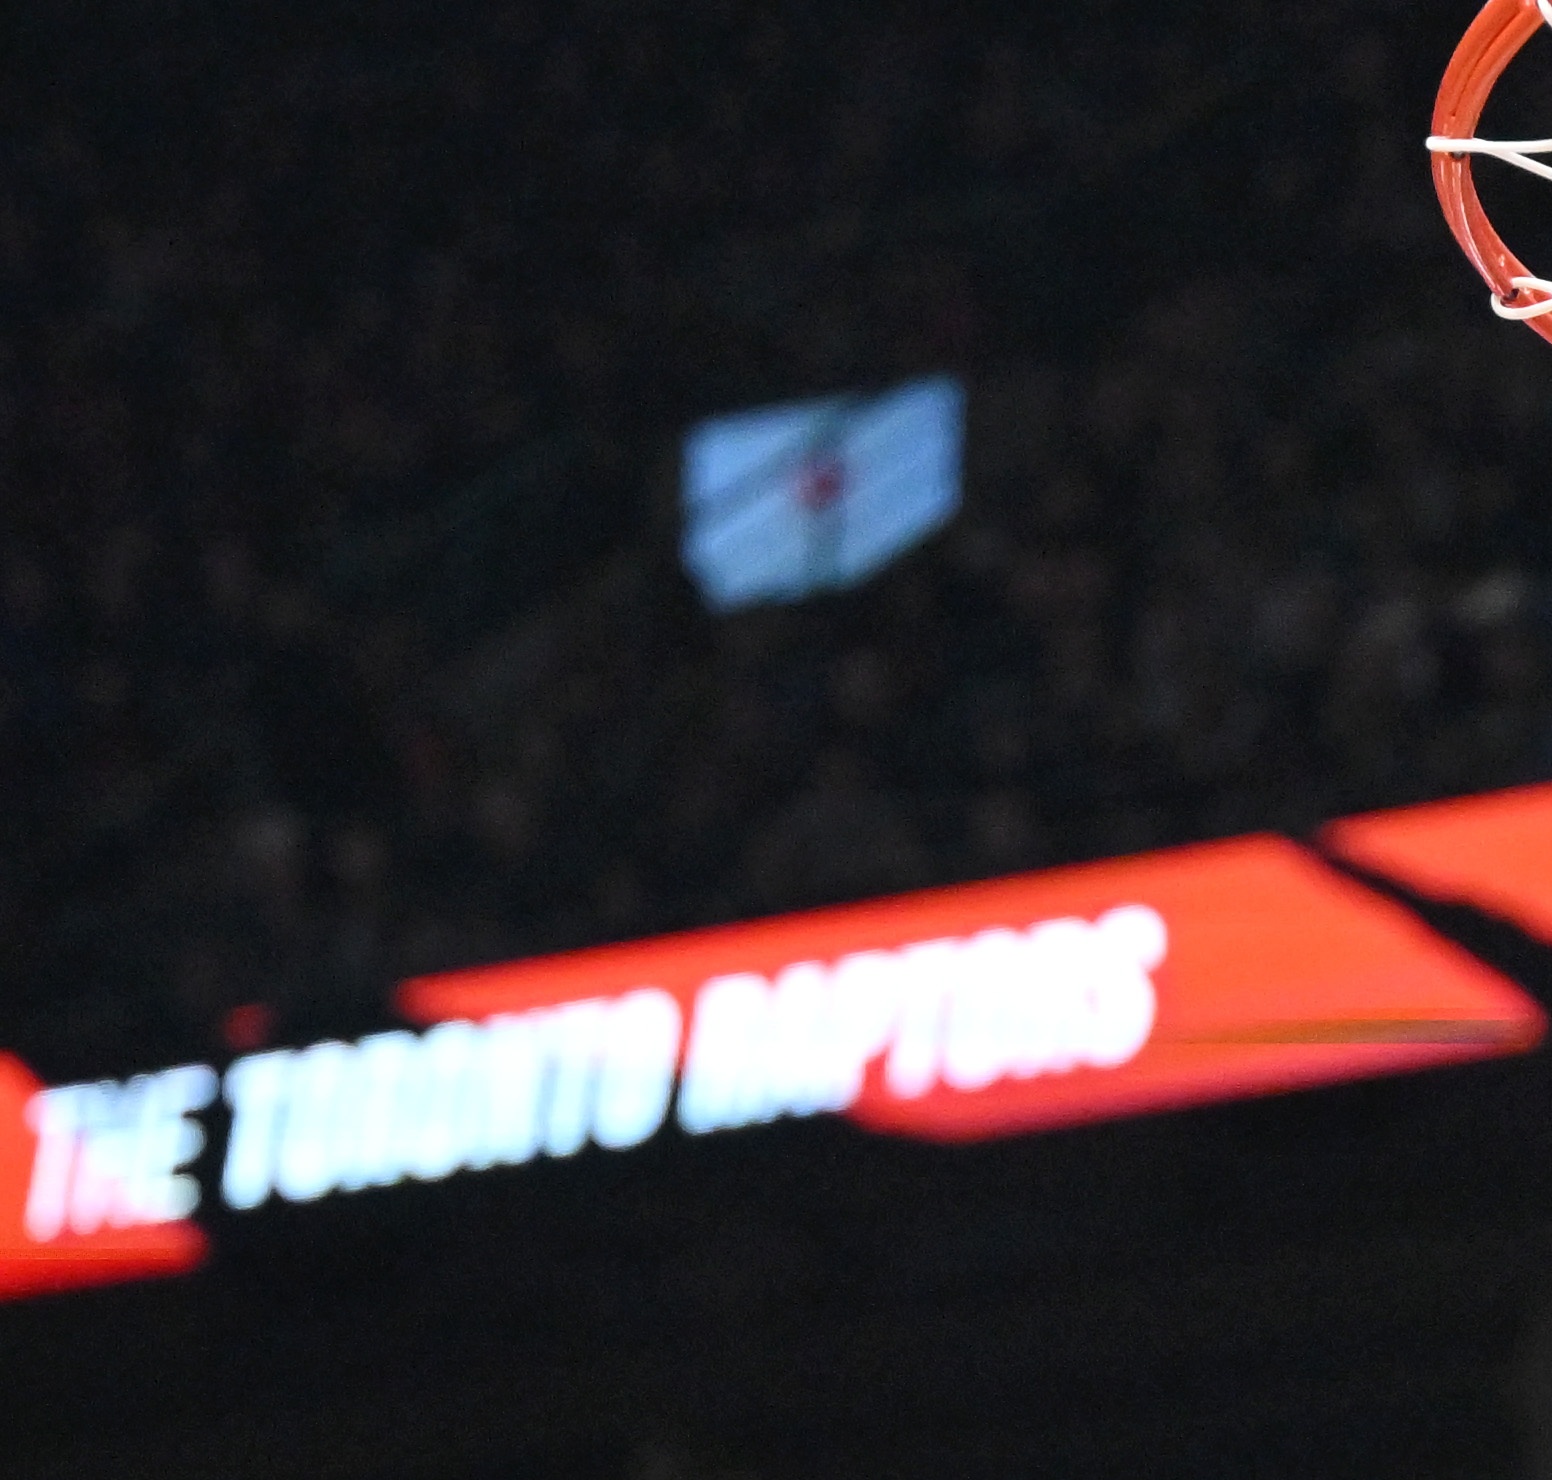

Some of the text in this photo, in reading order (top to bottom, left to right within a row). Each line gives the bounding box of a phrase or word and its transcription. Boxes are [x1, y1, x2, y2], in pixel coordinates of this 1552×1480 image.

[24, 903, 1167, 1242] THE TORONTO RAPTORS
